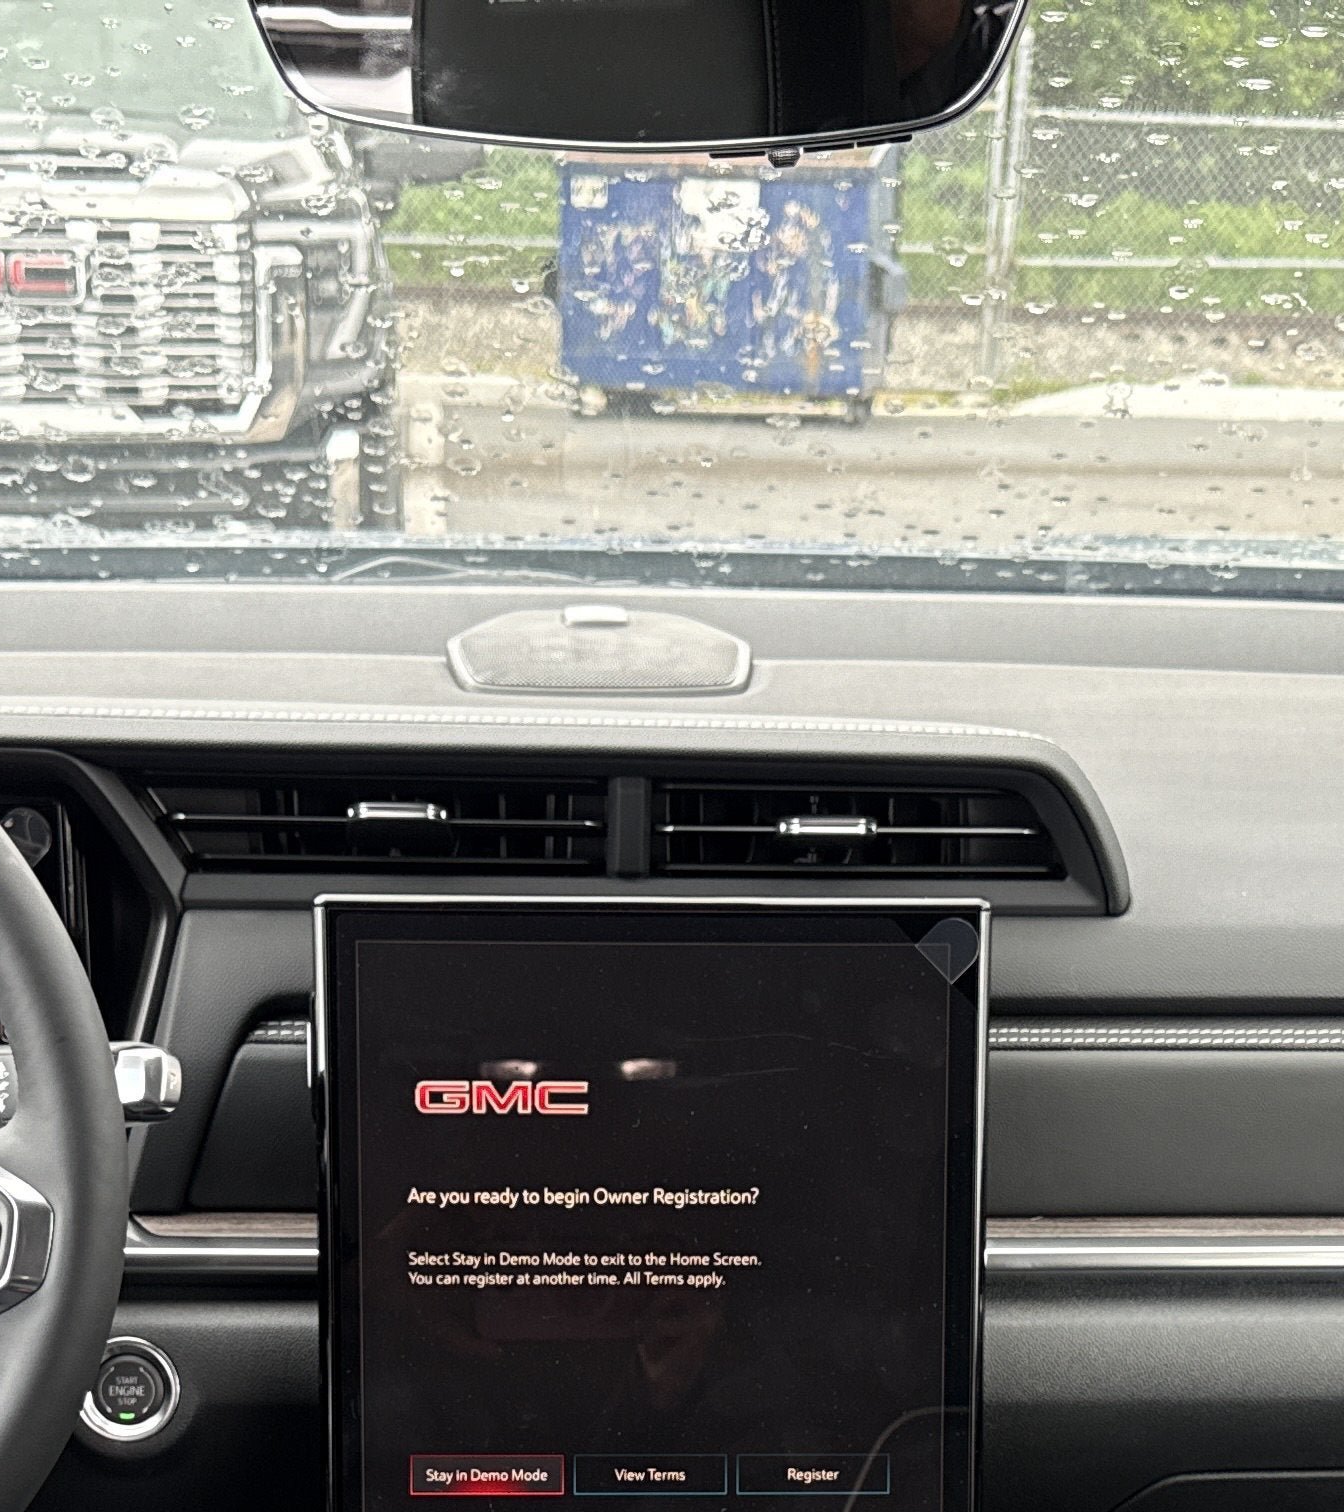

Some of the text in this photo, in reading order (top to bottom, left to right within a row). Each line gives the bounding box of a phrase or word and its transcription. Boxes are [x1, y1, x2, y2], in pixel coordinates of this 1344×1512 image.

[415, 1080, 590, 1114] GMC
[407, 1187, 759, 1208] Are you ready to begin Owner Registration?
[408, 1252, 762, 1269] Select Stay in Demo Mode to exit to the Home Screen.
[408, 1271, 726, 1288] You can register at another time. All Terms apply.
[116, 1376, 138, 1384] START
[108, 1385, 145, 1396] ENGINE
[117, 1397, 137, 1405] STOP
[426, 1468, 548, 1485] Stay in Demo Mode
[614, 1468, 686, 1482] View Terms
[787, 1468, 839, 1484] Register
